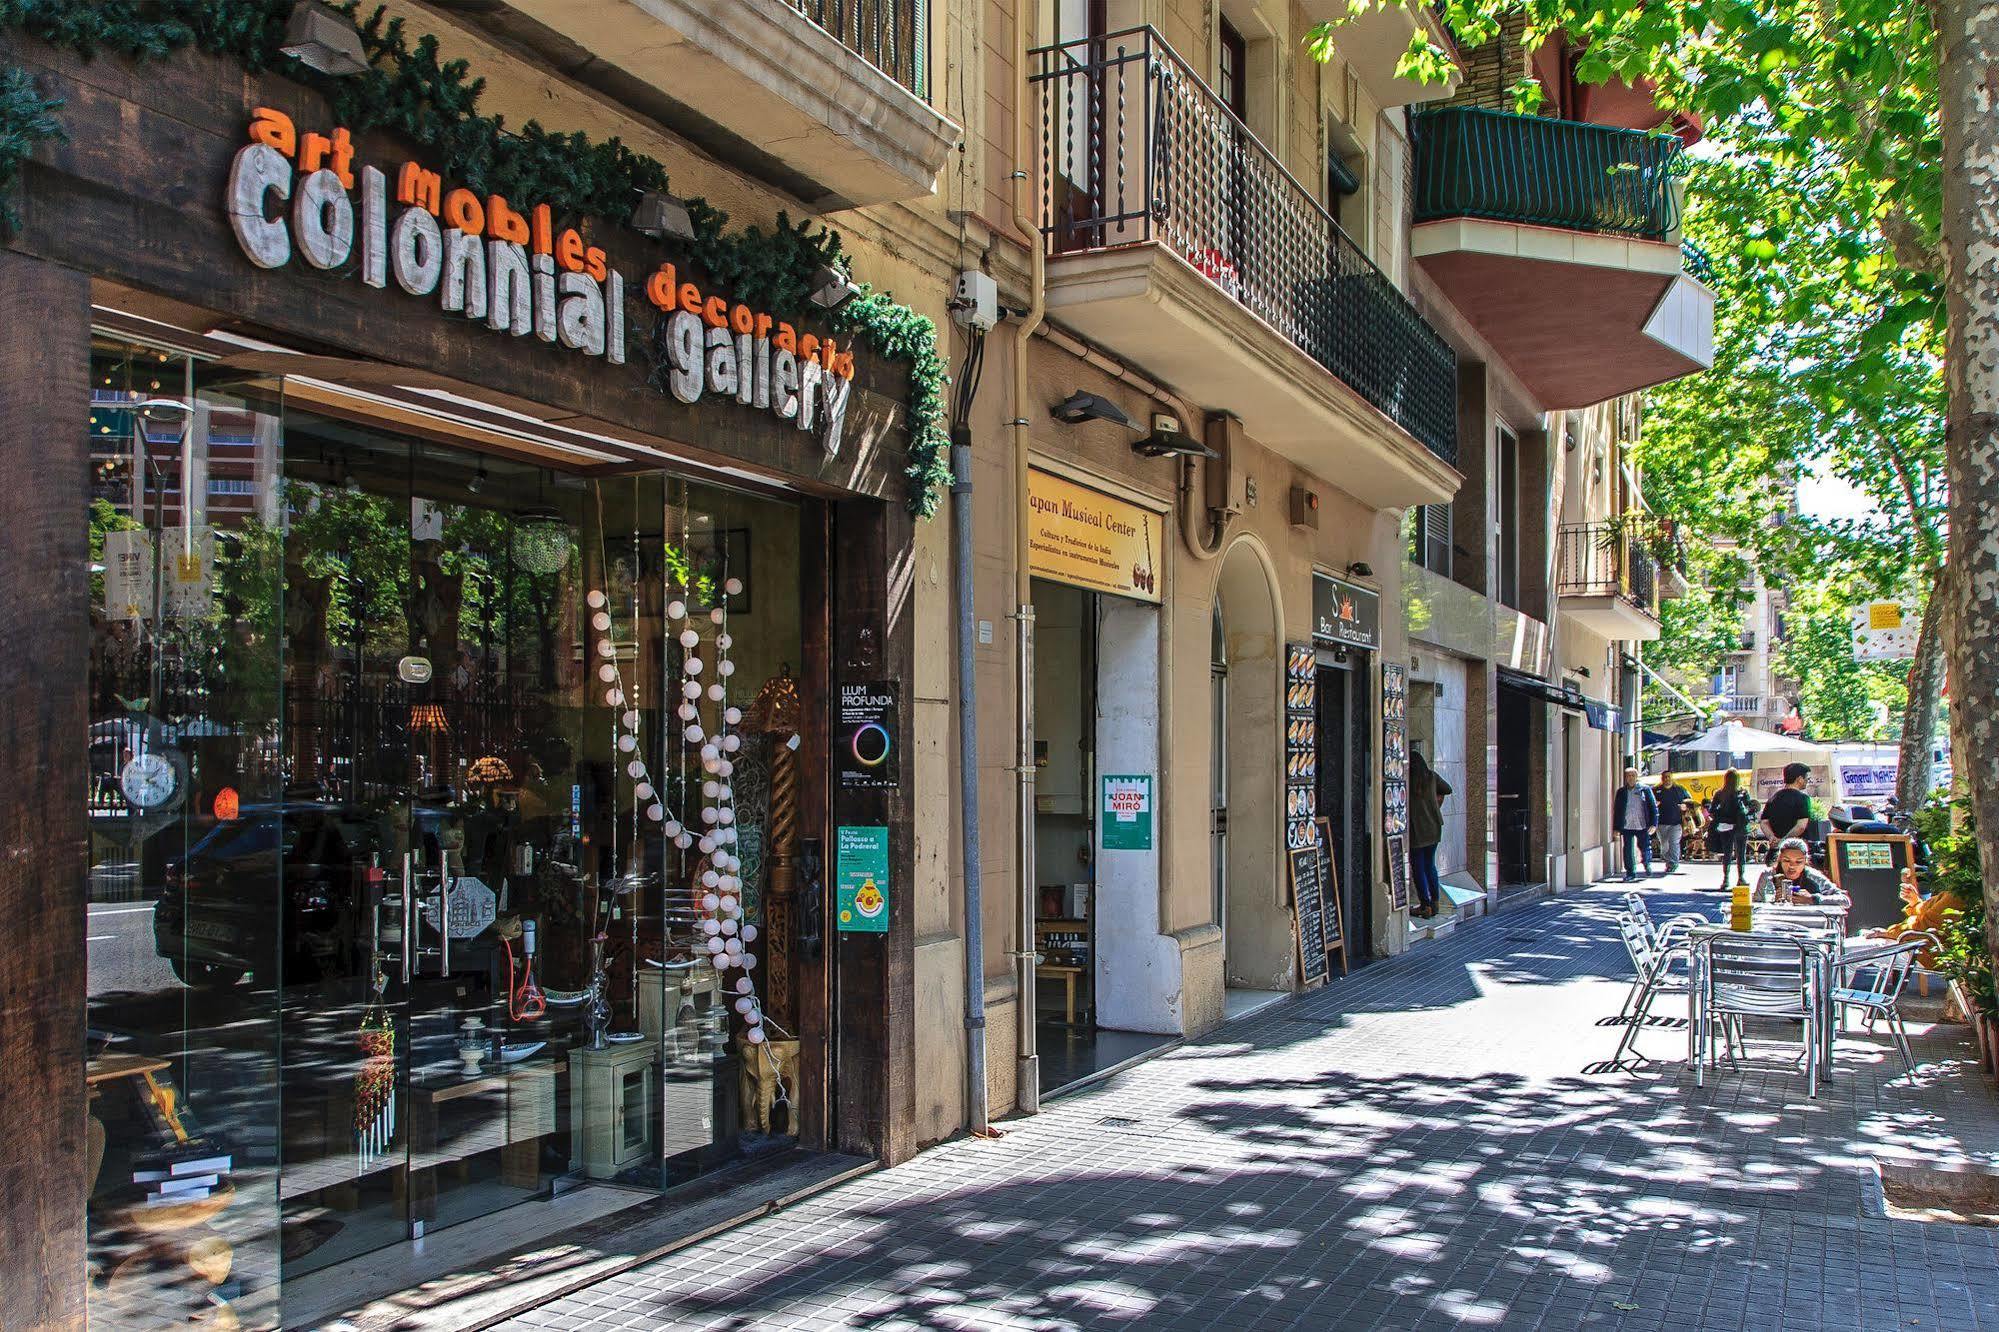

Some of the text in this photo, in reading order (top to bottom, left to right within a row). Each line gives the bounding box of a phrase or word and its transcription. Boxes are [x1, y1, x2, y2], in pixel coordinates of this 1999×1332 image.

[249, 106, 355, 190] art
[399, 161, 607, 283] mobles
[666, 310, 850, 456] gallery
[1028, 488, 1136, 538] apan Musical Center
[1320, 616, 1333, 634] Bar
[842, 685, 867, 696] LLUM
[842, 695, 894, 706] PROFUNDA
[1843, 771, 1872, 784] General
[1112, 793, 1142, 801] JOAN
[1112, 801, 1141, 811] MIRÓ
